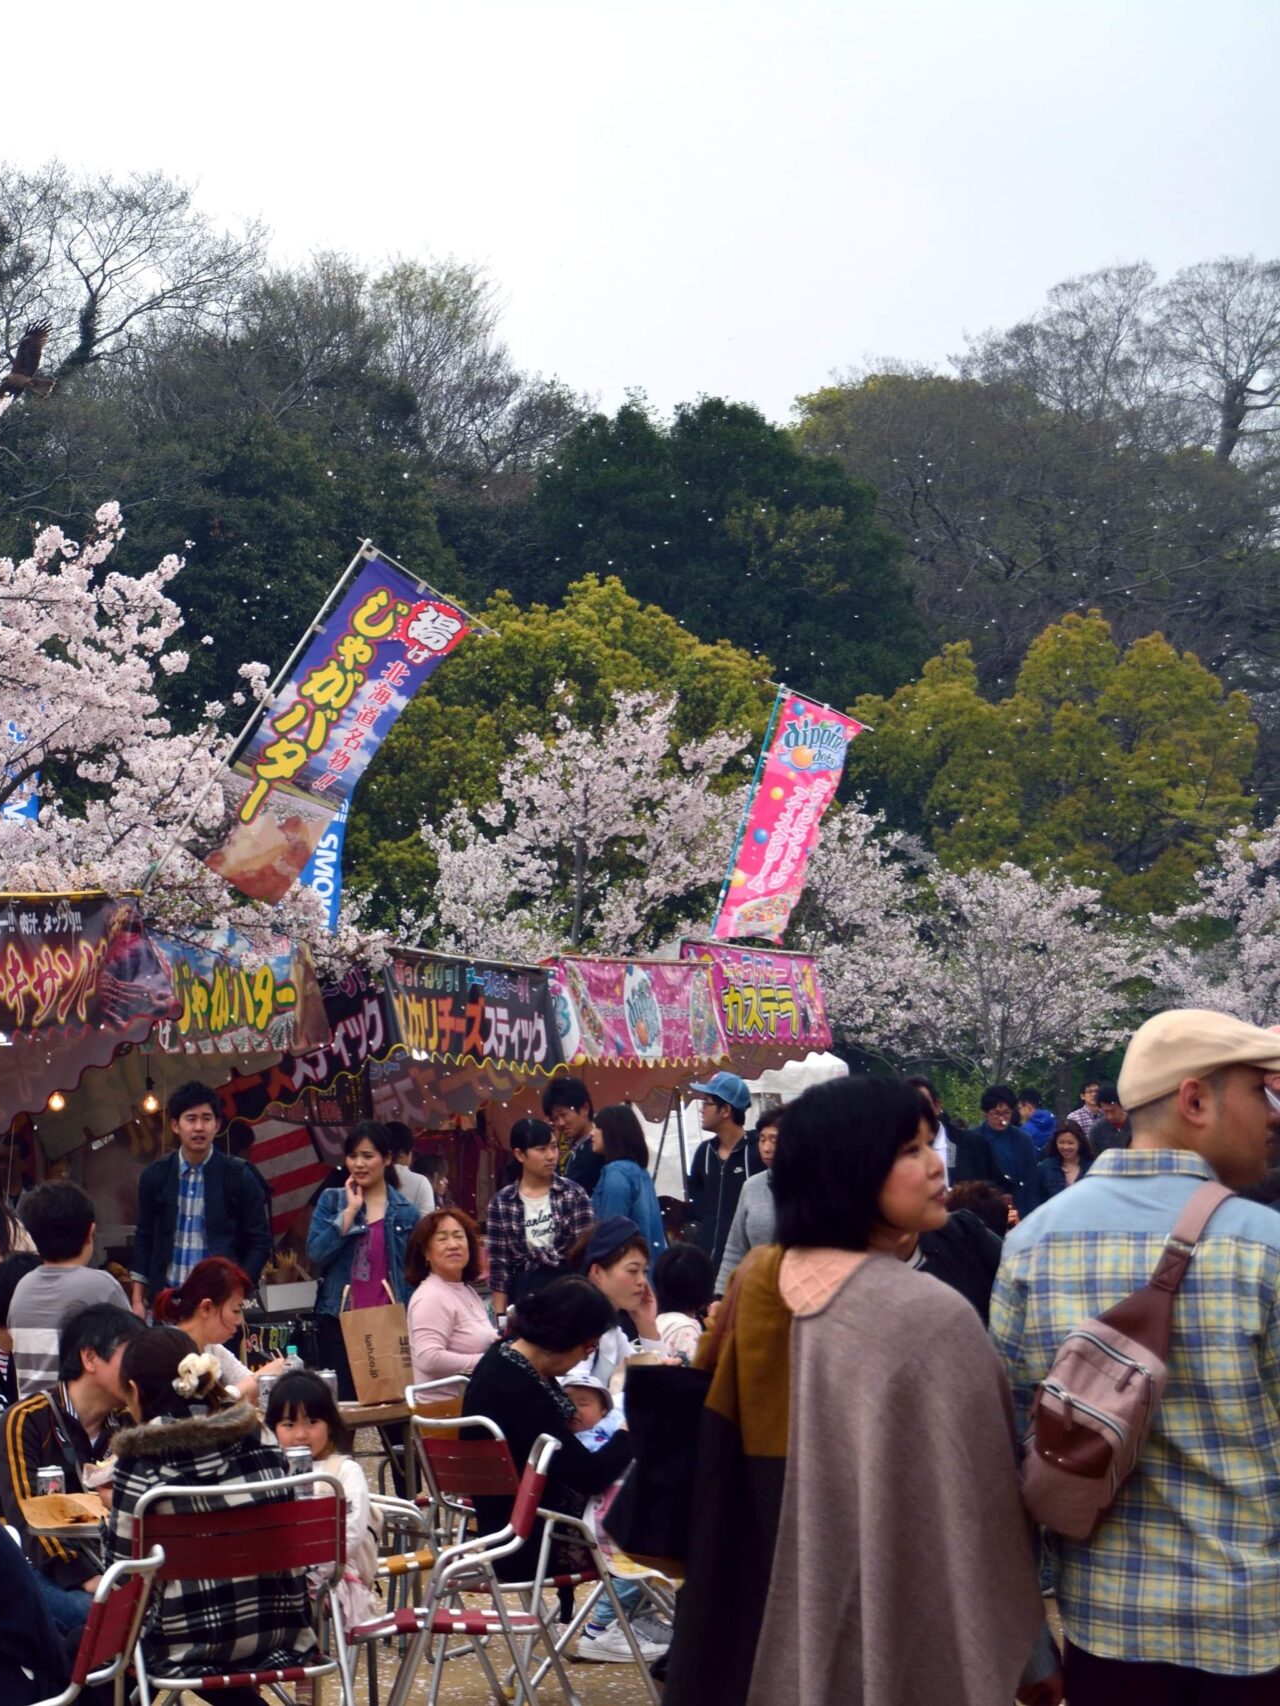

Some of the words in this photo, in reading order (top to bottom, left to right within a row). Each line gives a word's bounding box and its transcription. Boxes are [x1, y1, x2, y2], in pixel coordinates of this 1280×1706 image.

[237, 588, 410, 827] じゃがバター
[746, 785, 810, 893] アイスクリーム
[722, 982, 799, 1039] カステラ
[364, 1333, 379, 1379] lush.co.jp
